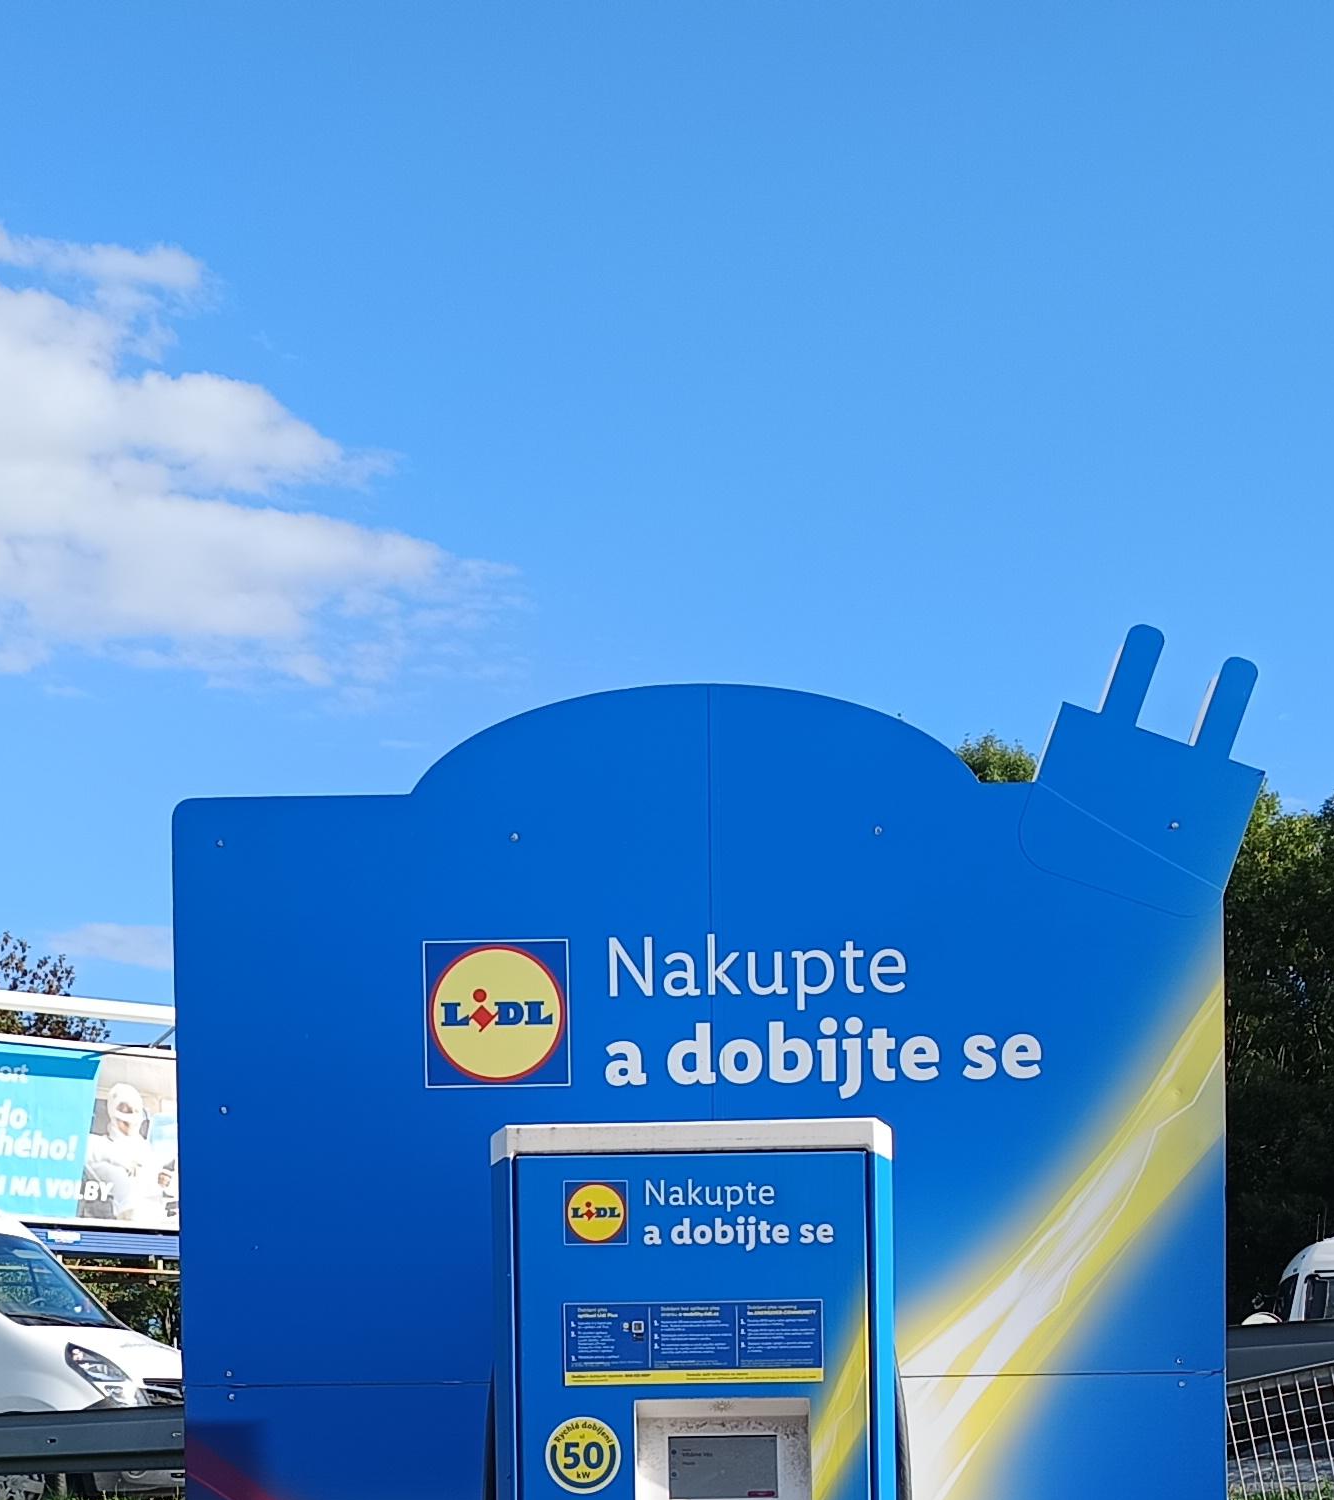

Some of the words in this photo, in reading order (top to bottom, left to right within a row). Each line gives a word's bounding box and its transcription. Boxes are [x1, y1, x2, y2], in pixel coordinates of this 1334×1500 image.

[607, 933, 907, 1010] Nakupte
[604, 1040, 647, 1087] a
[667, 1015, 940, 1099] dobijte
[962, 1031, 1043, 1080] se
[10, 1176, 42, 1198] NA
[644, 1178, 775, 1213] Nakupte
[643, 1224, 662, 1245] a
[670, 1215, 790, 1252] dobijte
[799, 1222, 835, 1244] se
[563, 1441, 604, 1470] 50
[576, 1471, 591, 1479] kW
